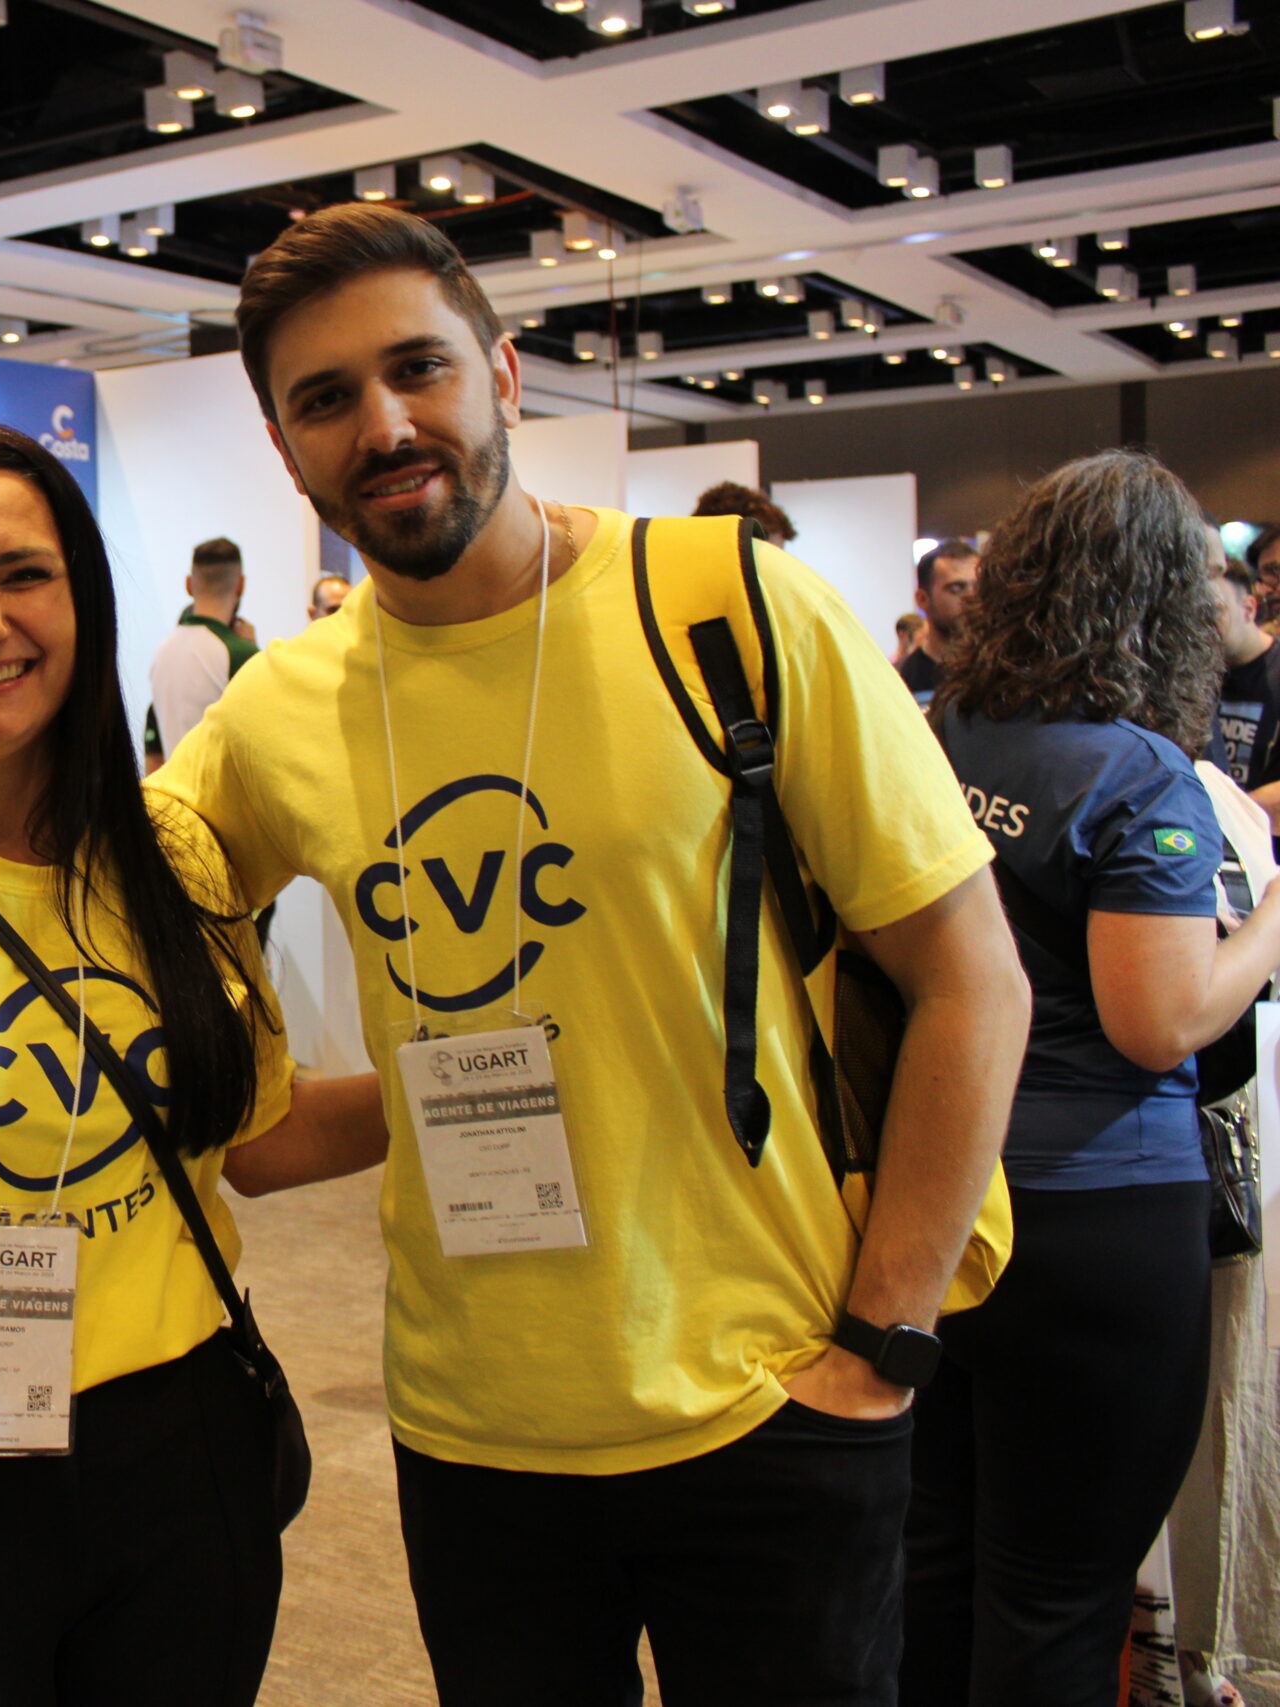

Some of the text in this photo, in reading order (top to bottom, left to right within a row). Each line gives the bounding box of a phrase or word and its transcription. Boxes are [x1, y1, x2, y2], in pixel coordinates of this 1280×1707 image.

[962, 776, 1030, 838] DES
[355, 842, 587, 941] CVC
[458, 1049, 529, 1073] UGART
[423, 1095, 556, 1120] AGENTE DE VIAGENS
[12, 1299, 69, 1313] VIAGENS
